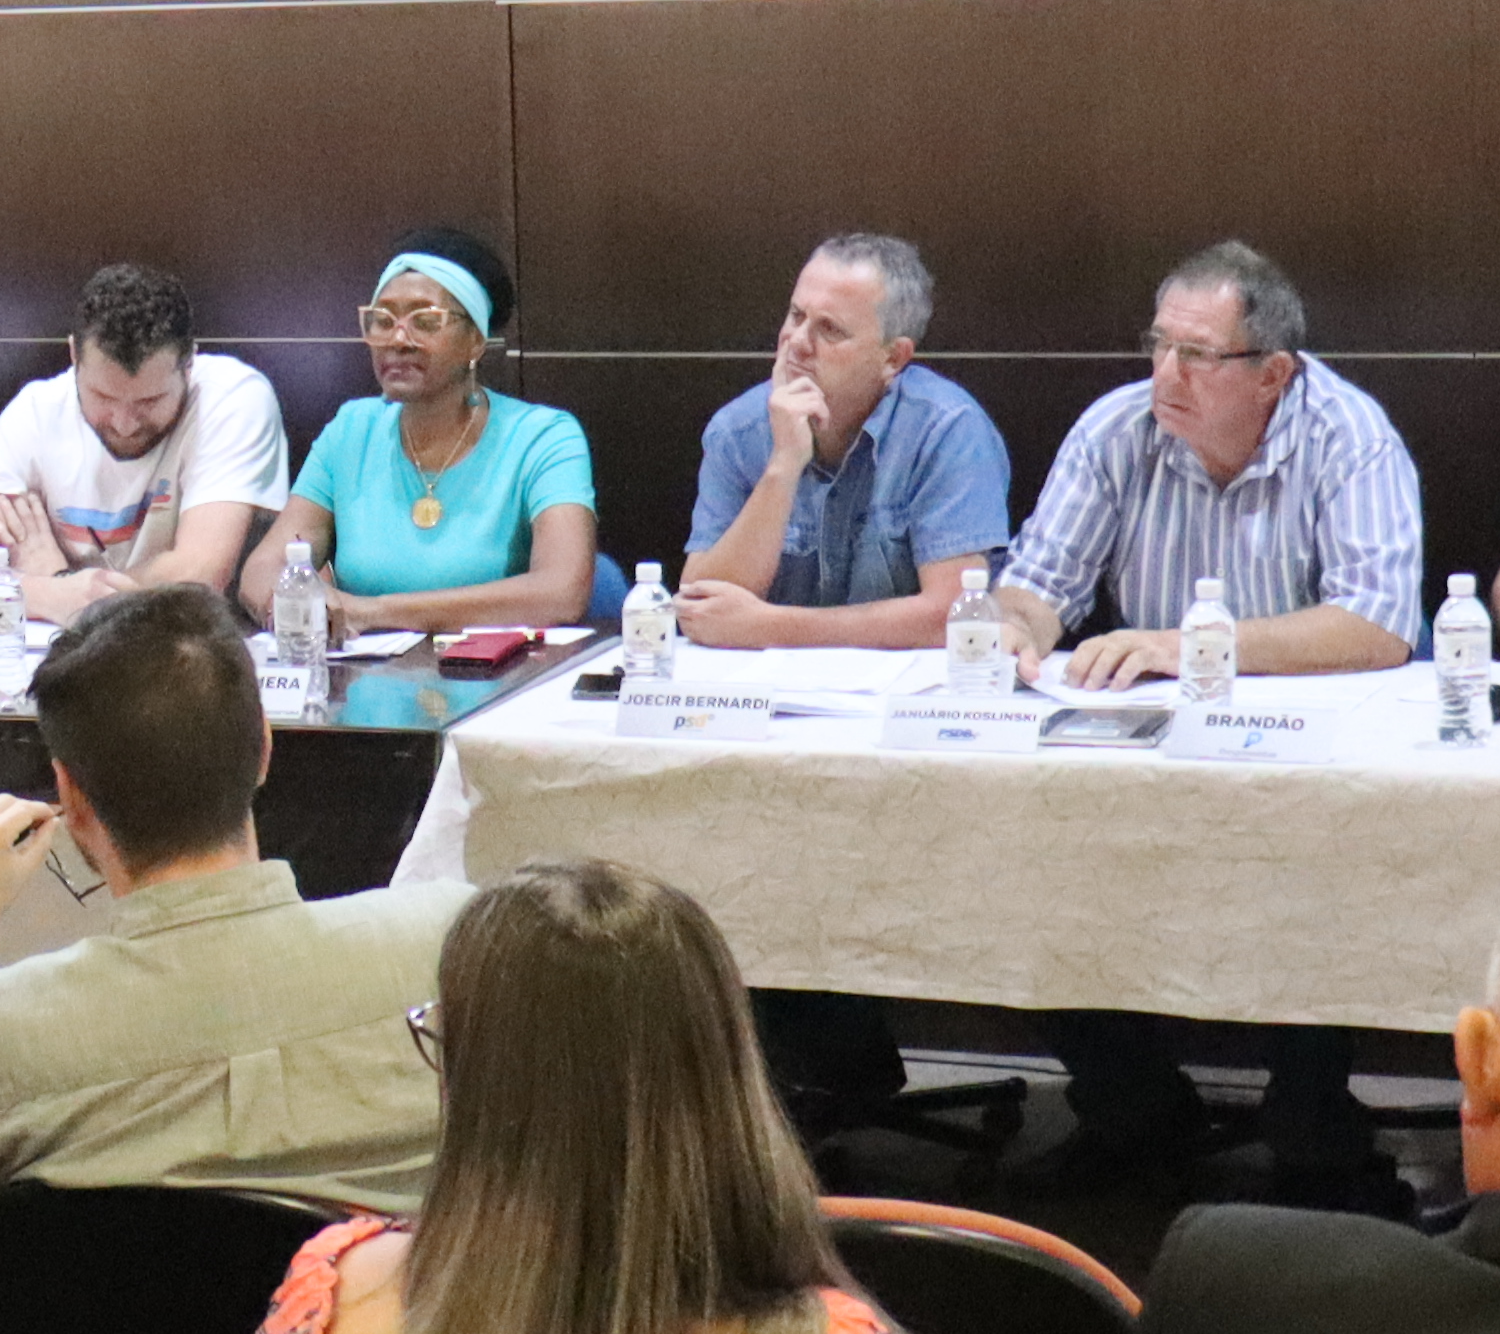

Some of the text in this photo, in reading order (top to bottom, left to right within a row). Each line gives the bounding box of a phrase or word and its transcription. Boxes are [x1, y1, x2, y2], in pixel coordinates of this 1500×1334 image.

[623, 694, 769, 709] JOECIR BERNARDI
[890, 709, 1037, 722] JANUÁRIO KOSLINSKI
[1205, 714, 1305, 731] BRANDÃO
